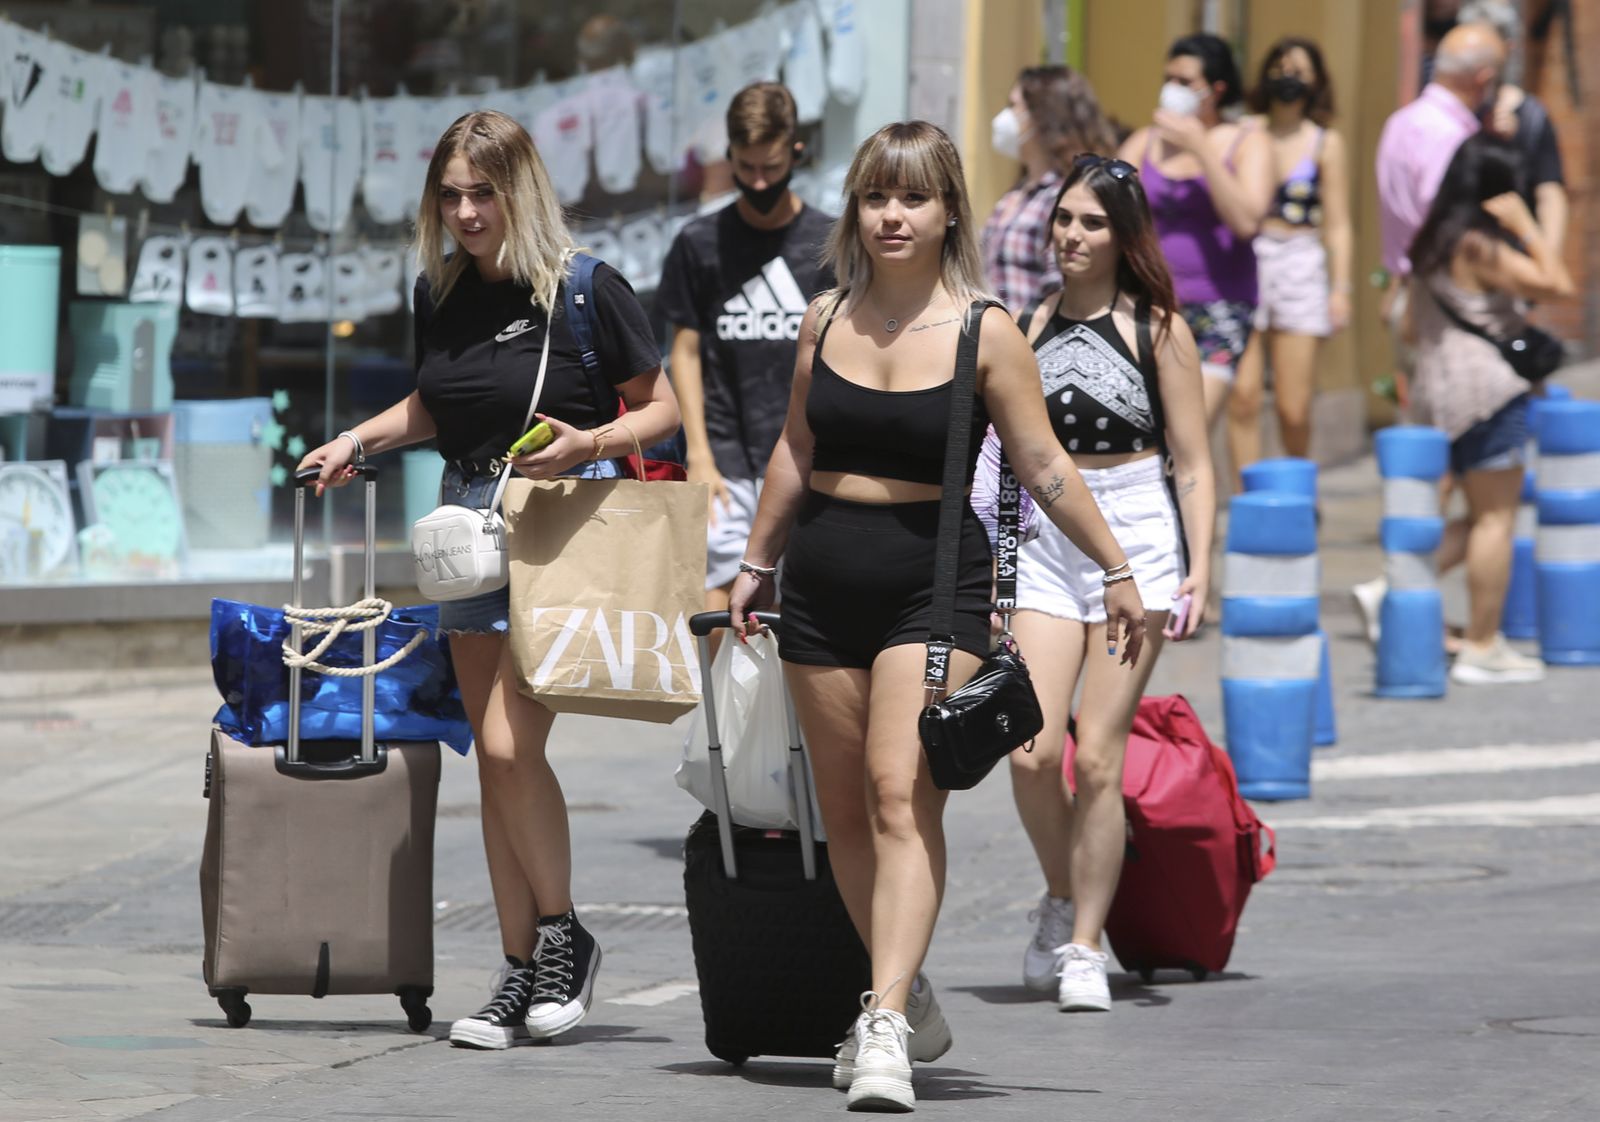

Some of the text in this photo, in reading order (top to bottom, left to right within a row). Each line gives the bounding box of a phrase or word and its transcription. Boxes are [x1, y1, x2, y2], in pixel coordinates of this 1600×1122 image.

[503, 319, 529, 333] NIKE
[717, 309, 804, 341] adida
[449, 544, 473, 557] JEANS
[1005, 525, 1017, 577] LOLA
[532, 606, 703, 695] ZARA
